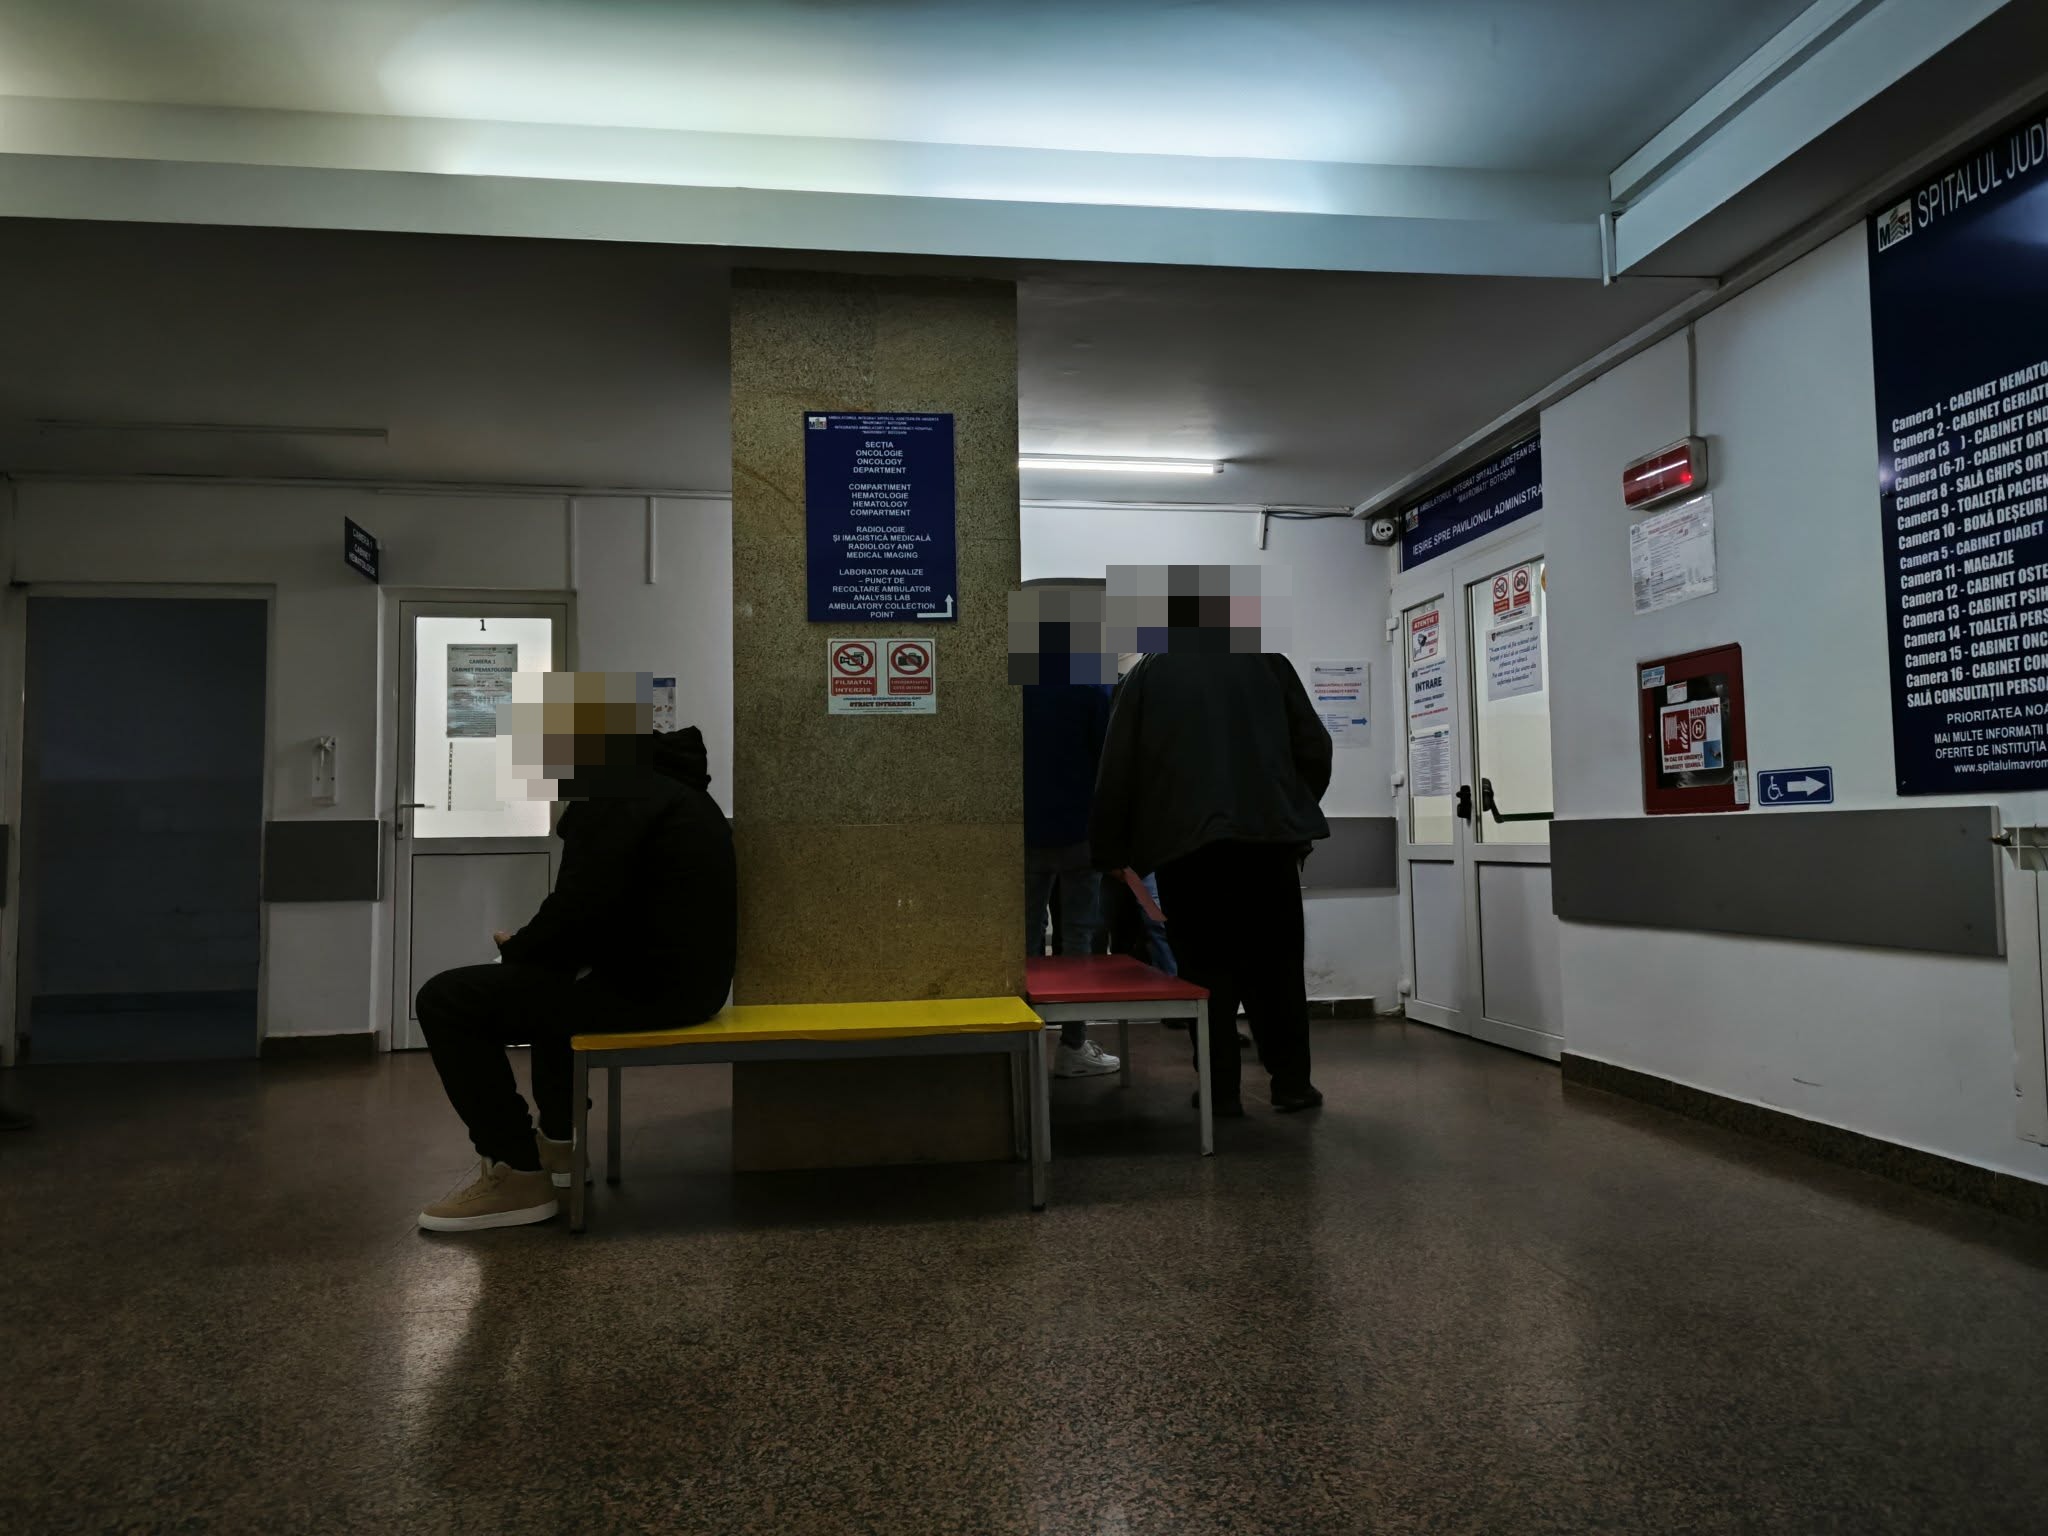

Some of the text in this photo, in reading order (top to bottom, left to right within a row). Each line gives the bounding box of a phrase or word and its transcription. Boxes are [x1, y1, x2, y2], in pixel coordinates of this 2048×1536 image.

[1918, 151, 2002, 228] SPITALUL
[1892, 407, 1934, 433] Camera
[1936, 402, 1941, 416] 1
[1950, 380, 1997, 412] CABINET
[1893, 428, 1935, 452] Camera
[1937, 422, 1944, 437] 2
[1952, 401, 2000, 431] CABINET
[1894, 447, 1936, 472] Camera
[1974, 414, 2024, 445] CABINET
[1528, 442, 1537, 454] DE
[1895, 466, 1937, 492] Camera
[1939, 456, 1965, 478] (6-7)
[1974, 436, 2023, 466] CABINET
[1896, 488, 1938, 511] Camera
[1940, 482, 1948, 498] 8
[1956, 469, 1984, 493] SALĂ
[1986, 459, 2023, 484] GHIPS
[1897, 508, 1939, 530] Camera
[1941, 503, 1949, 518] 9
[1957, 484, 2005, 514] TOALETĂ
[1898, 528, 1940, 550] Camera
[1943, 522, 1955, 538] 10
[1964, 509, 1995, 533] BOXĂ
[1997, 496, 2047, 524] DEȘEURI
[842, 534, 889, 542] IMAGISTICĂ
[890, 534, 931, 542] MEDICALĂ
[1433, 528, 1451, 548] SPRE
[1452, 508, 1493, 538] PAVILIONUL
[1900, 548, 1939, 570] Camera
[1941, 546, 1948, 559] 5
[1956, 532, 2001, 555] CABINET
[2003, 520, 2044, 544] DIABET
[1900, 568, 1943, 590] Camera
[1944, 563, 1956, 579] 11
[1964, 549, 2015, 574] MAGAZIE
[1902, 588, 1944, 609] Camera
[1946, 584, 1958, 599] 12
[1967, 570, 2016, 595] CABINET
[2018, 563, 2048, 584] OSTE
[479, 619, 487, 631] 1
[1903, 608, 1945, 629] Camera
[1946, 604, 1959, 619] 13
[1968, 592, 2017, 616] CABINET
[1904, 628, 1946, 648] Camera
[1948, 625, 1960, 640] 14
[1969, 612, 2018, 637] TOALETĂ
[2020, 609, 2048, 628] PERS
[1905, 647, 1947, 668] Camera
[1949, 646, 1962, 661] 15
[1971, 636, 2020, 658] CABINET
[2022, 631, 2048, 650] ONC
[1415, 676, 1442, 692] INTRARE
[1906, 668, 1948, 688] Camera
[1950, 666, 1963, 682] 16
[1972, 658, 2021, 679] CABINET
[1907, 676, 2048, 708] SALĂ CONSULTAȚII PERSO
[1690, 704, 1719, 716] HIDRANT
[1695, 723, 1702, 734] H
[1947, 706, 2022, 724] PRIORITATEA
[1934, 733, 1950, 744] MAI
[1952, 730, 1983, 742] MULTE
[1985, 724, 2043, 739] INFORMAȚII
[1936, 741, 2047, 759] OFERITE DE INSTITUȚIA
